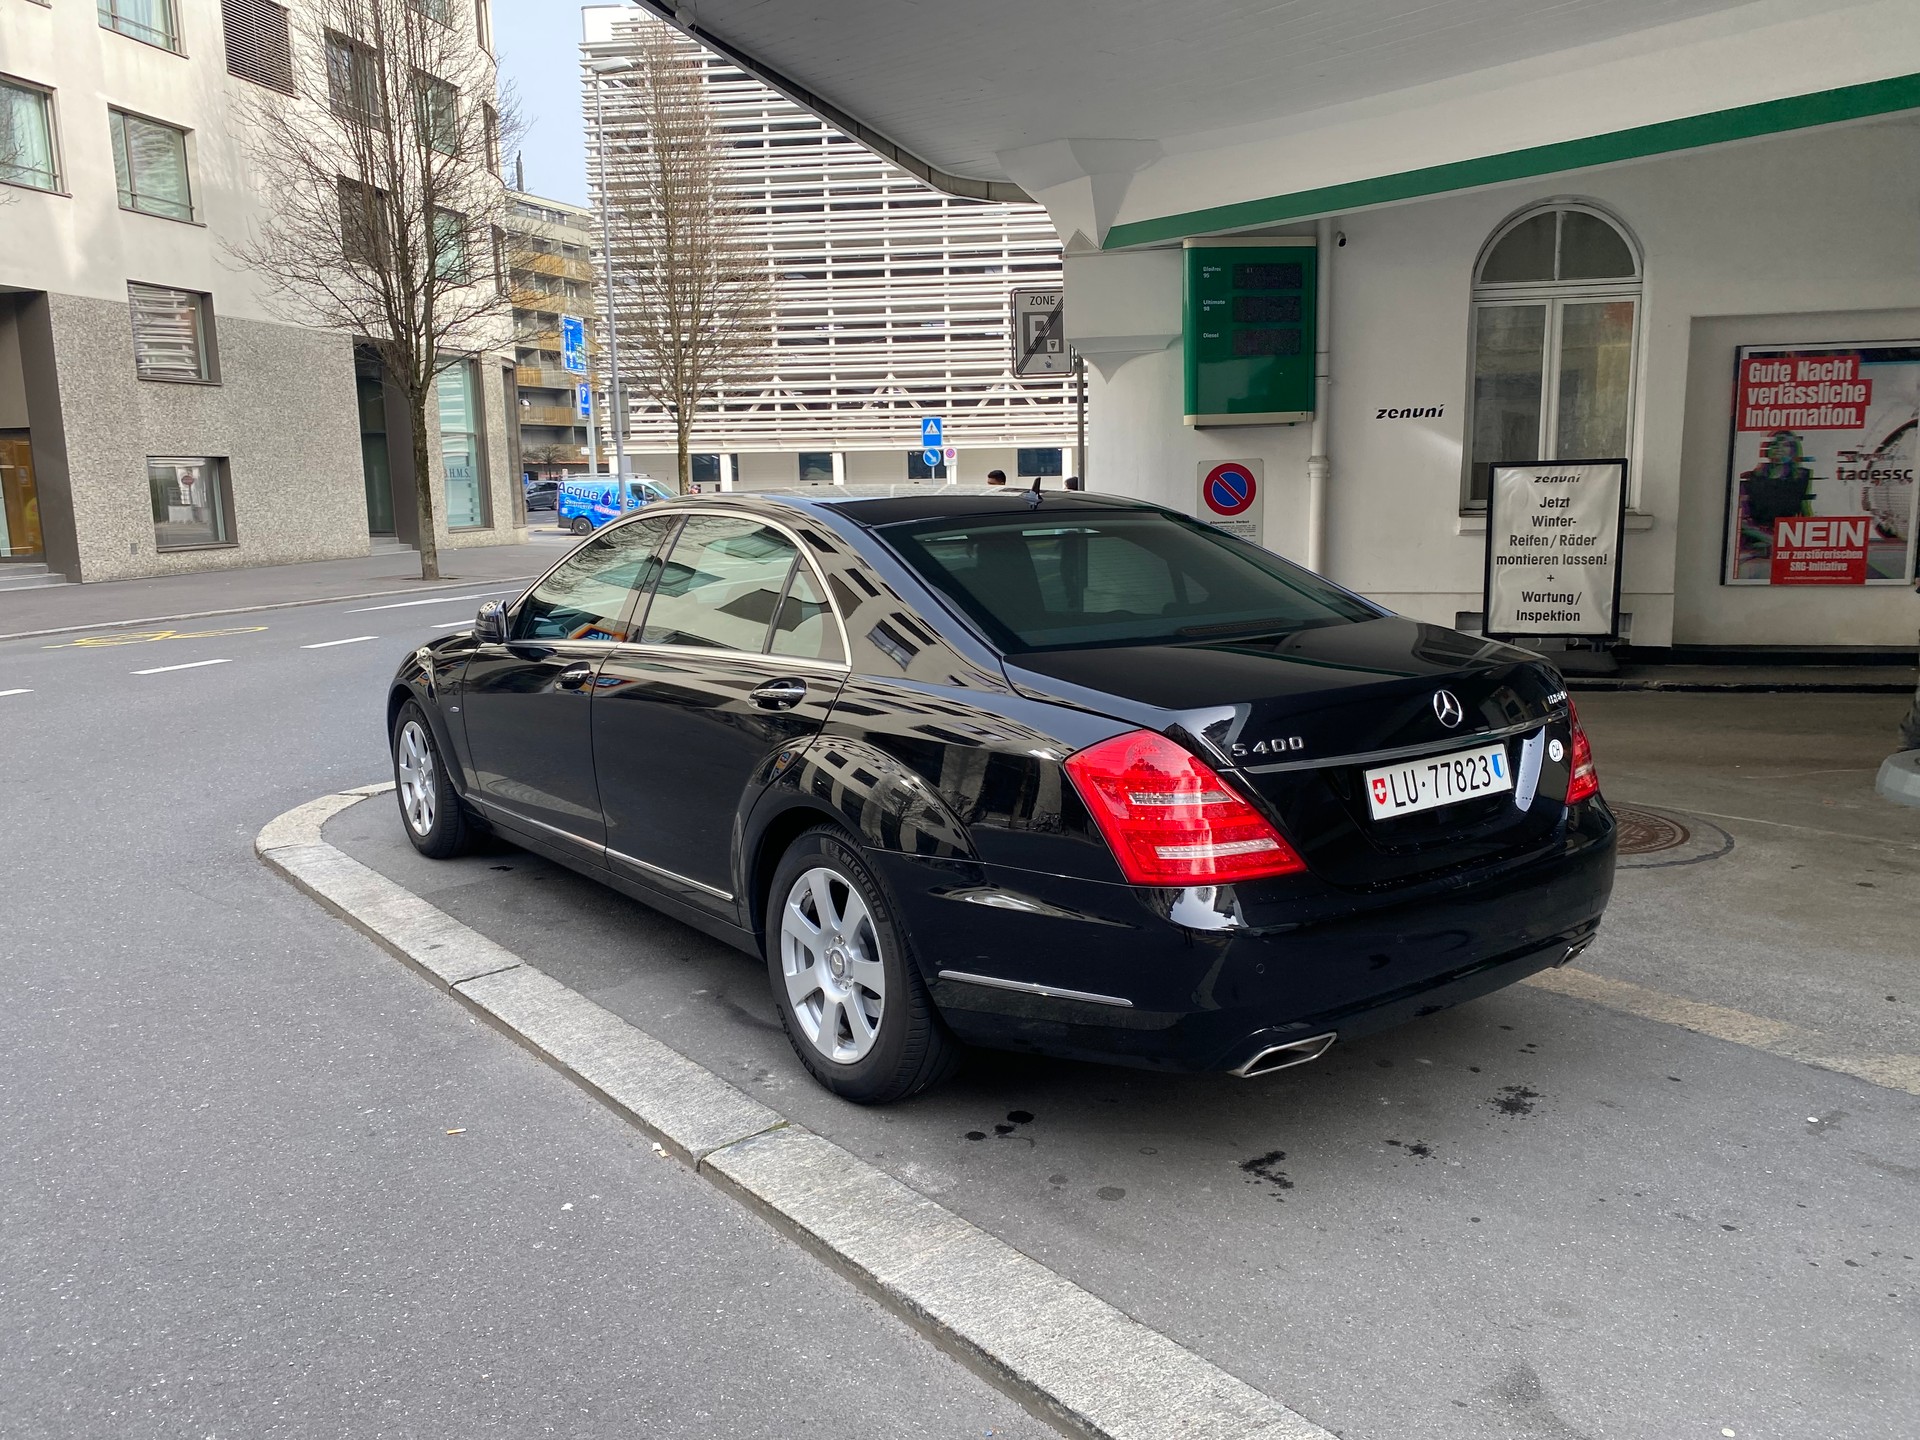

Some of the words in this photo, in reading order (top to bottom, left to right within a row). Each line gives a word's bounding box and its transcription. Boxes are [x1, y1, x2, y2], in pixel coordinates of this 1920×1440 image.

[1030, 295, 1055, 306] ZONE
[1748, 362, 1793, 384] Gute
[1796, 360, 1854, 382] Nacht
[1747, 382, 1867, 406] verlässliche
[1375, 403, 1445, 420] zenuni
[1745, 405, 1862, 428] Information.
[1534, 473, 1582, 484] zenuni
[558, 482, 599, 500] Acqua
[1539, 496, 1570, 509] Jetzt
[1531, 515, 1577, 527] Winter-
[1509, 534, 1549, 547] Reifen
[1559, 533, 1597, 546] Räder
[1777, 521, 1866, 548] NEIN
[1496, 553, 1559, 566] montieren
[1562, 552, 1608, 566] lassen!
[1776, 551, 1791, 560] zur
[1792, 549, 1863, 560] zerstörerischen
[1790, 561, 1848, 571] SRG-Initiative
[1547, 574, 1555, 582] +
[1516, 609, 1580, 624] Inspektion
[1232, 743, 1249, 757] S
[1252, 735, 1305, 755] 400
[1551, 744, 1561, 758] CH
[840, 852, 887, 919] MICHELIN
